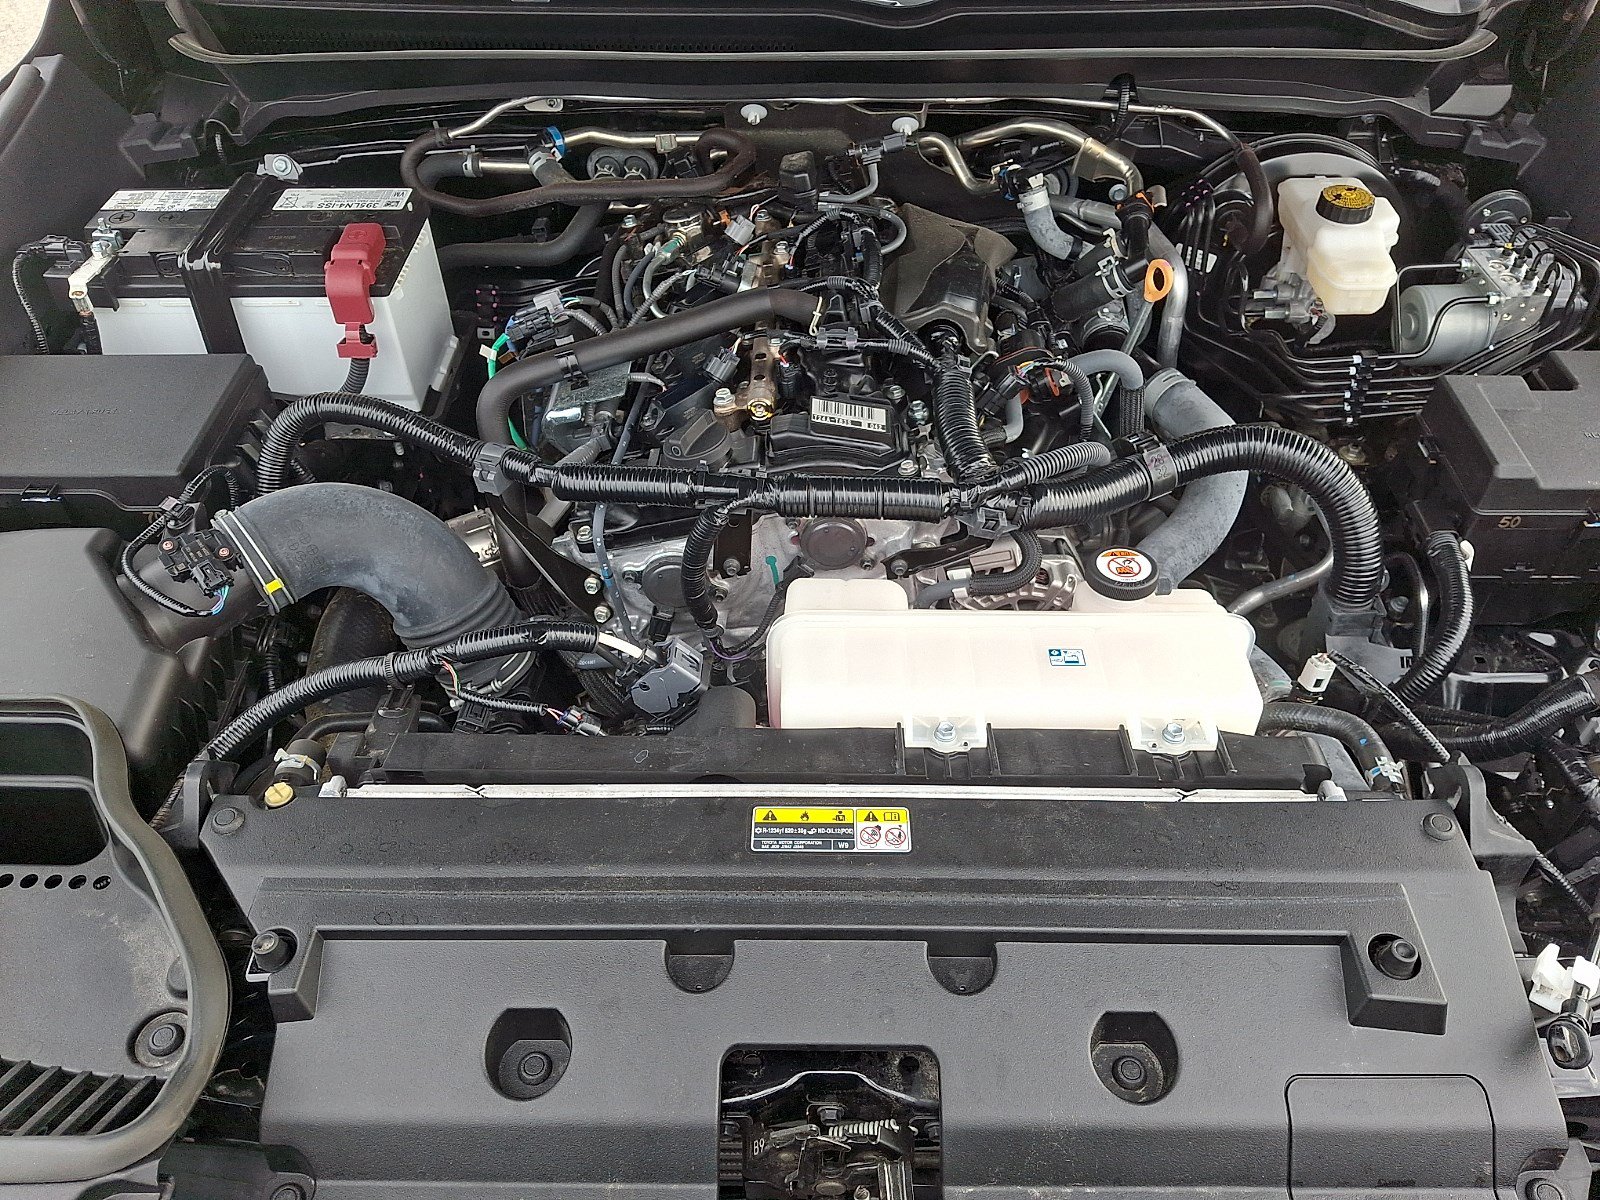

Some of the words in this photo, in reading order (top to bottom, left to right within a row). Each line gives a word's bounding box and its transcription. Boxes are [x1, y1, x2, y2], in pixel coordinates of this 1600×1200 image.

[1498, 515, 1522, 528] 50
[837, 841, 849, 849] W9
[753, 1137, 765, 1156] B9
